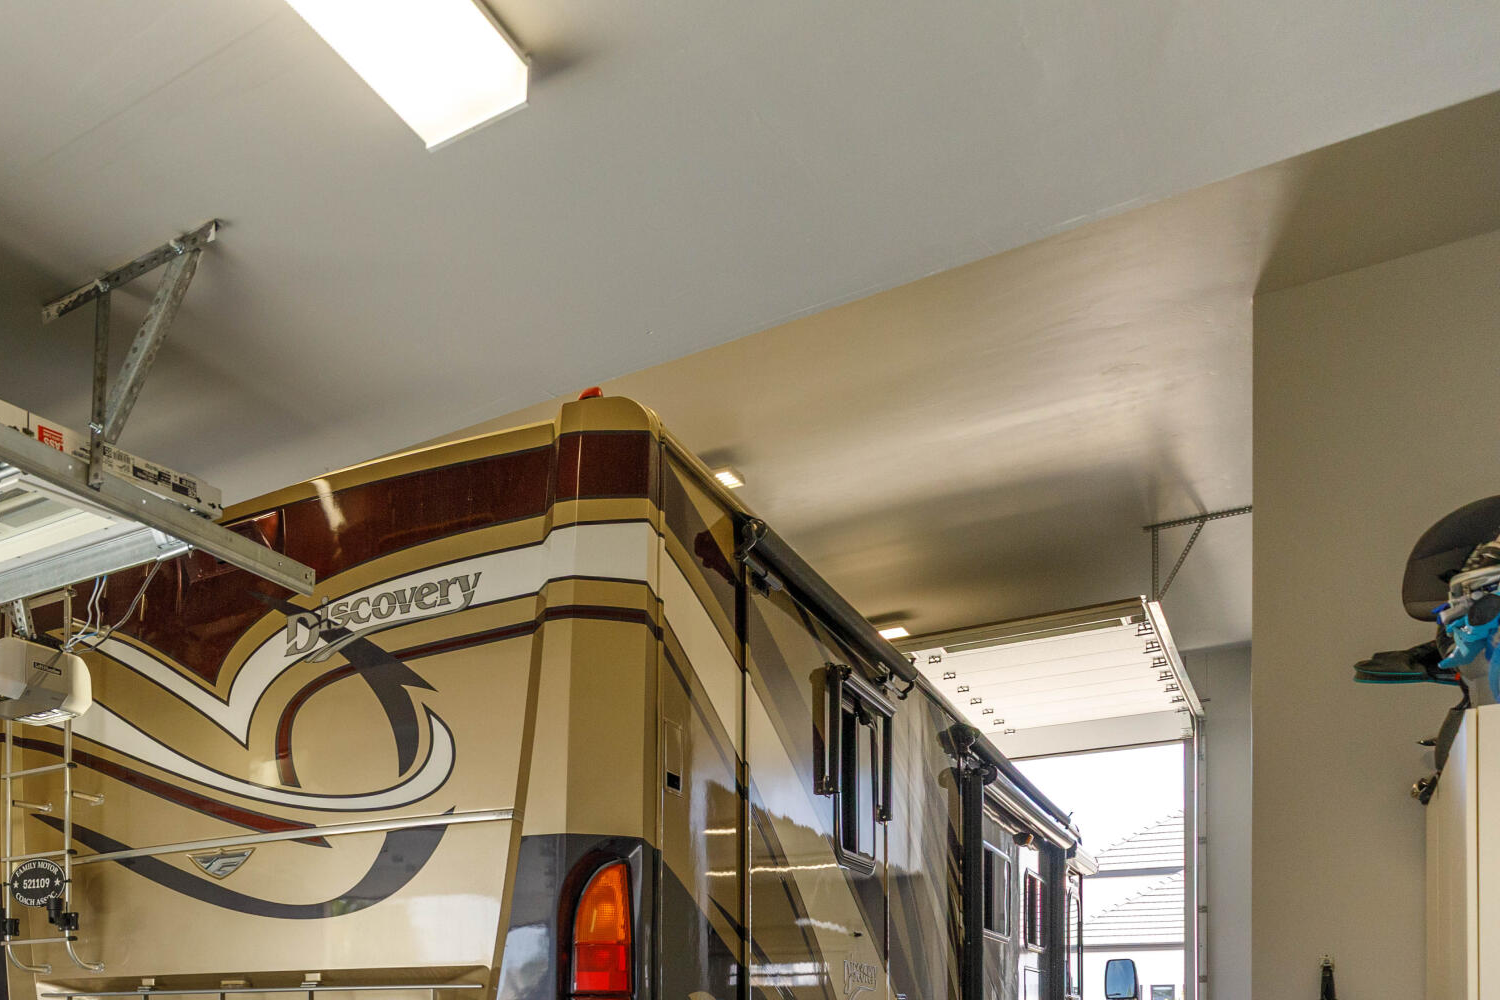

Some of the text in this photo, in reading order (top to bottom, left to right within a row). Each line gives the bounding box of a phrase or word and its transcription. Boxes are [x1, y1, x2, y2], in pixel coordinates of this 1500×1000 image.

[284, 572, 482, 657] Discovery
[15, 860, 59, 878] FAMILY MOTOR
[22, 877, 50, 890] 521109
[15, 892, 35, 905] COACH
